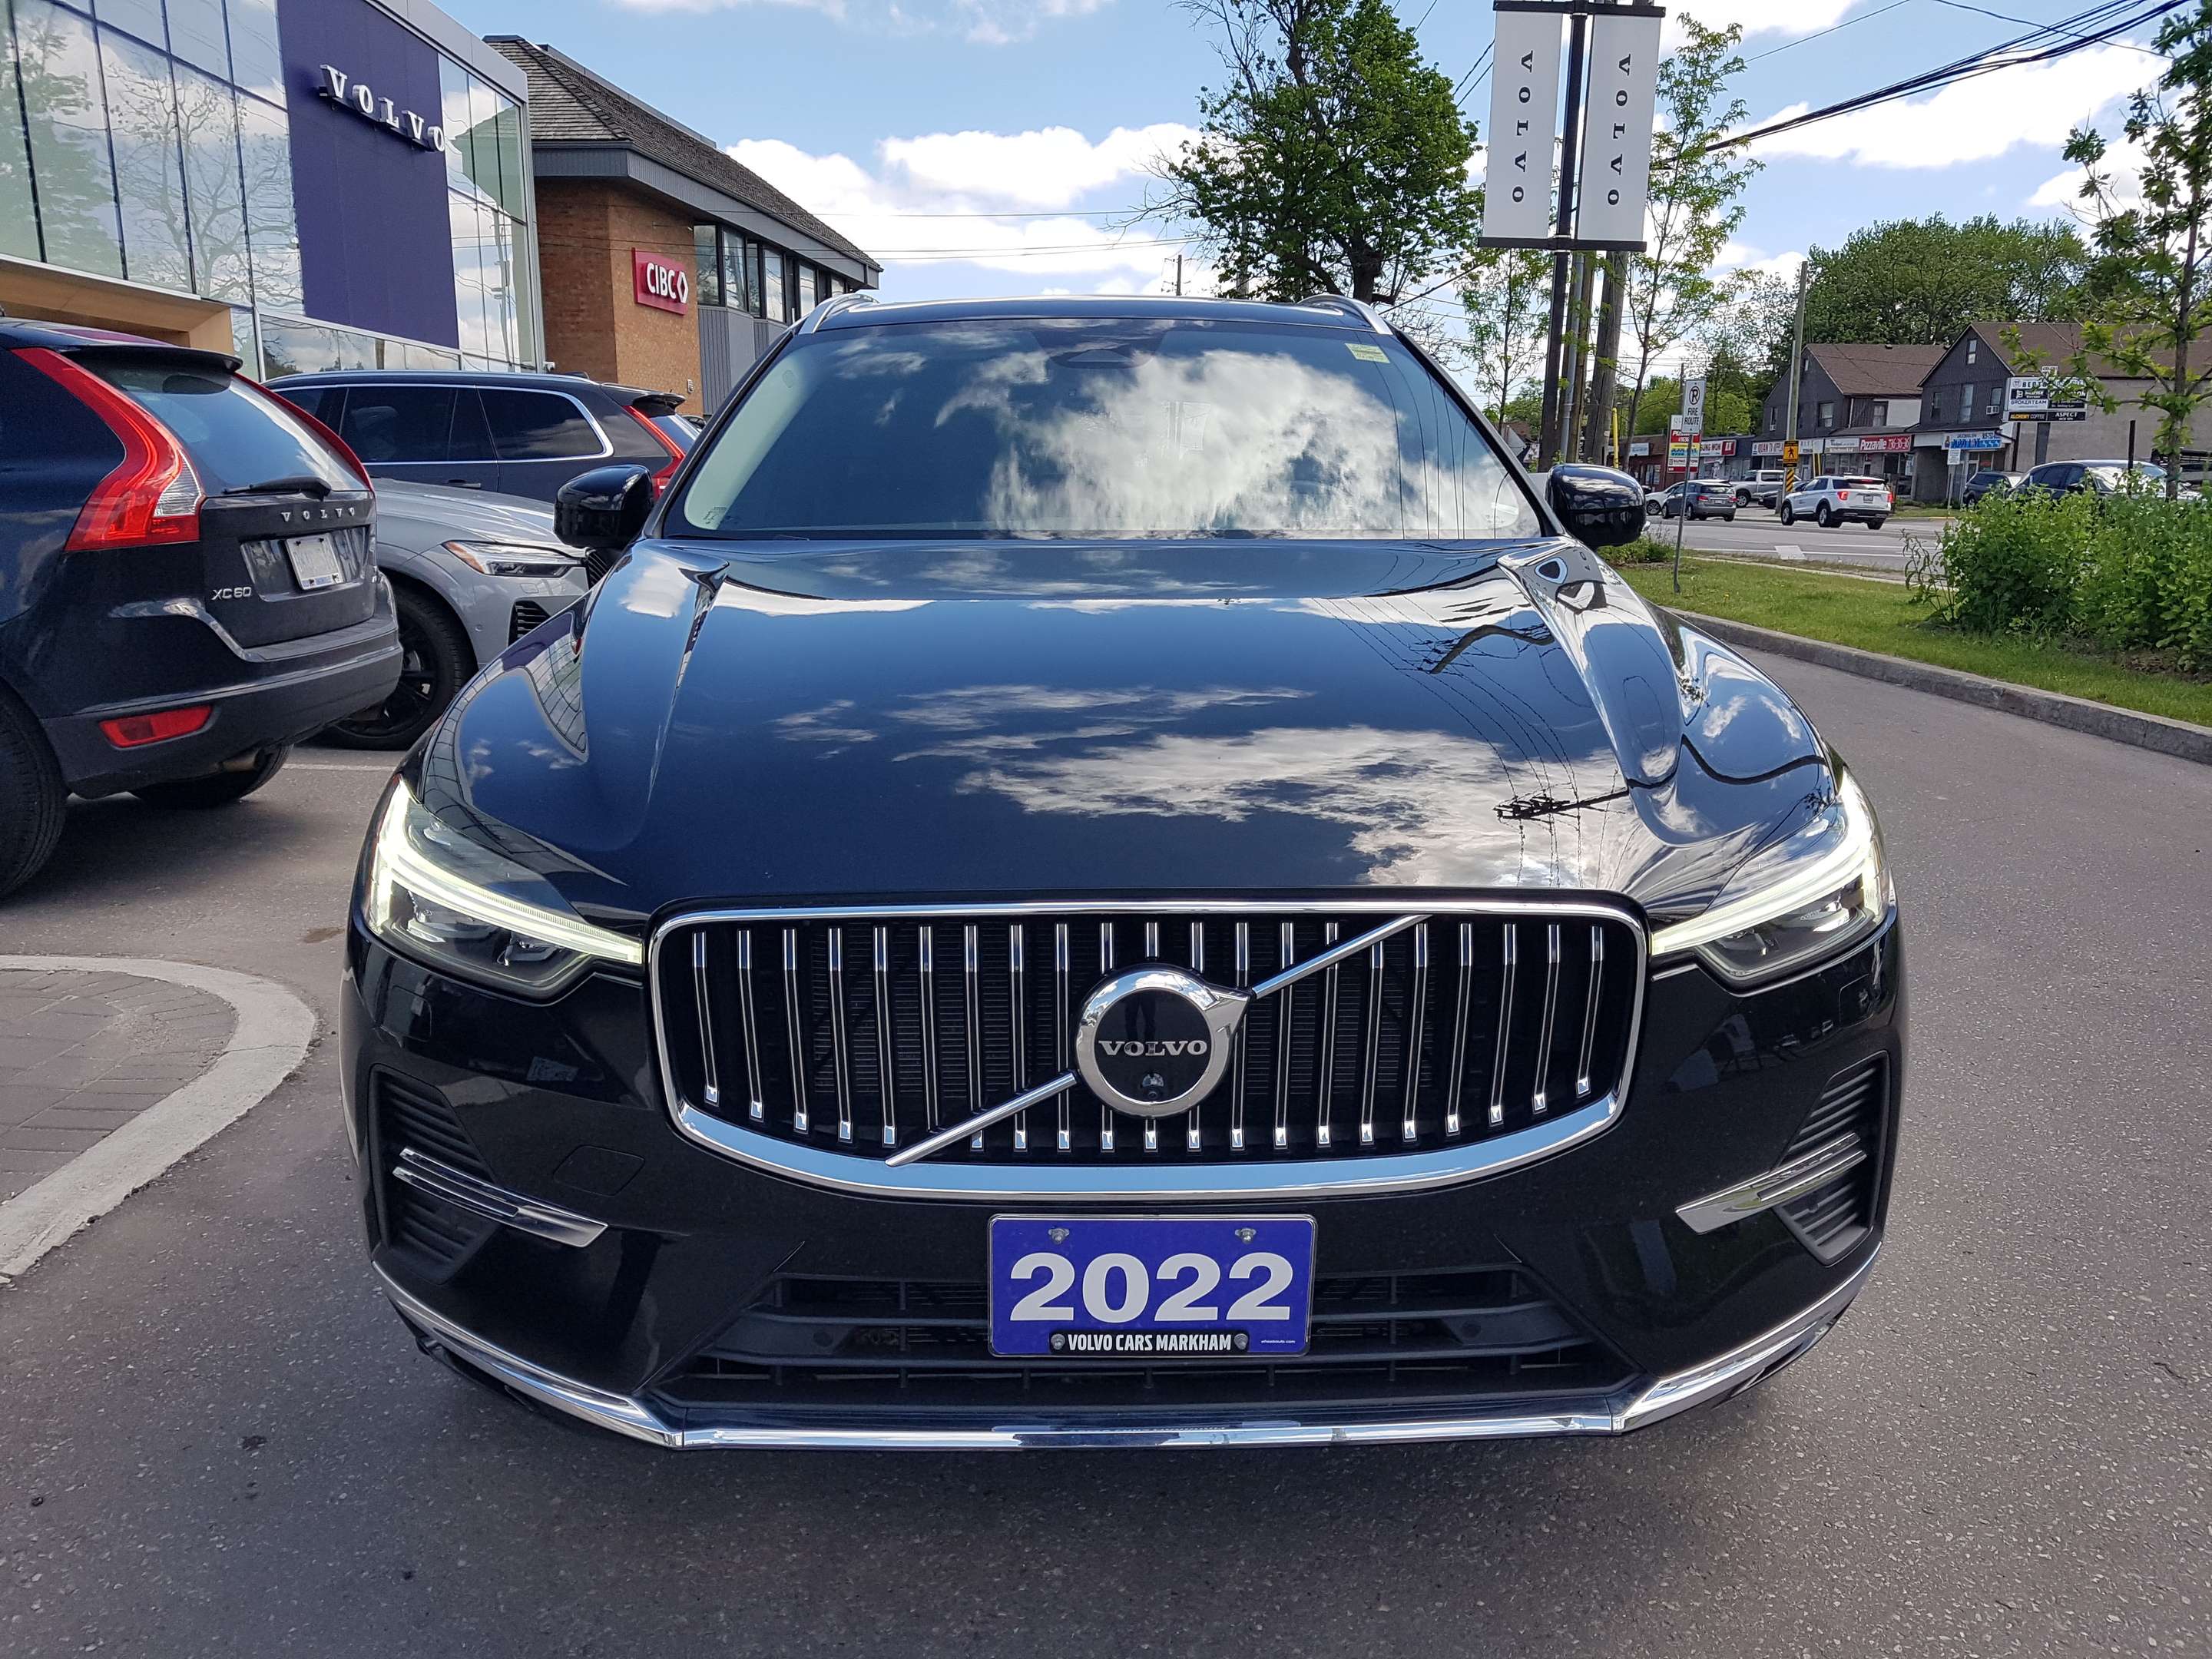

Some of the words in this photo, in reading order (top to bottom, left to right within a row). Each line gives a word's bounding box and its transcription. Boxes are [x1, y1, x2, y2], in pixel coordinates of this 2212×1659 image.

[320, 64, 445, 153] VOLVO
[1512, 50, 1533, 203] VOLVO
[1608, 53, 1631, 206] VOLVO
[646, 262, 676, 300] CIBC
[1687, 407, 1699, 416] FIRE
[1684, 417, 1700, 426] ROUTE
[1860, 438, 1887, 451] Pizzaville
[280, 507, 356, 523] VOLVO
[210, 586, 252, 601] XC60
[1098, 1040, 1207, 1056] VOLVO
[1010, 1252, 1293, 1323] 2022
[1068, 1333, 1114, 1351] VOLVO
[1116, 1333, 1153, 1351] CARS
[1156, 1333, 1232, 1351] MARKHAM
